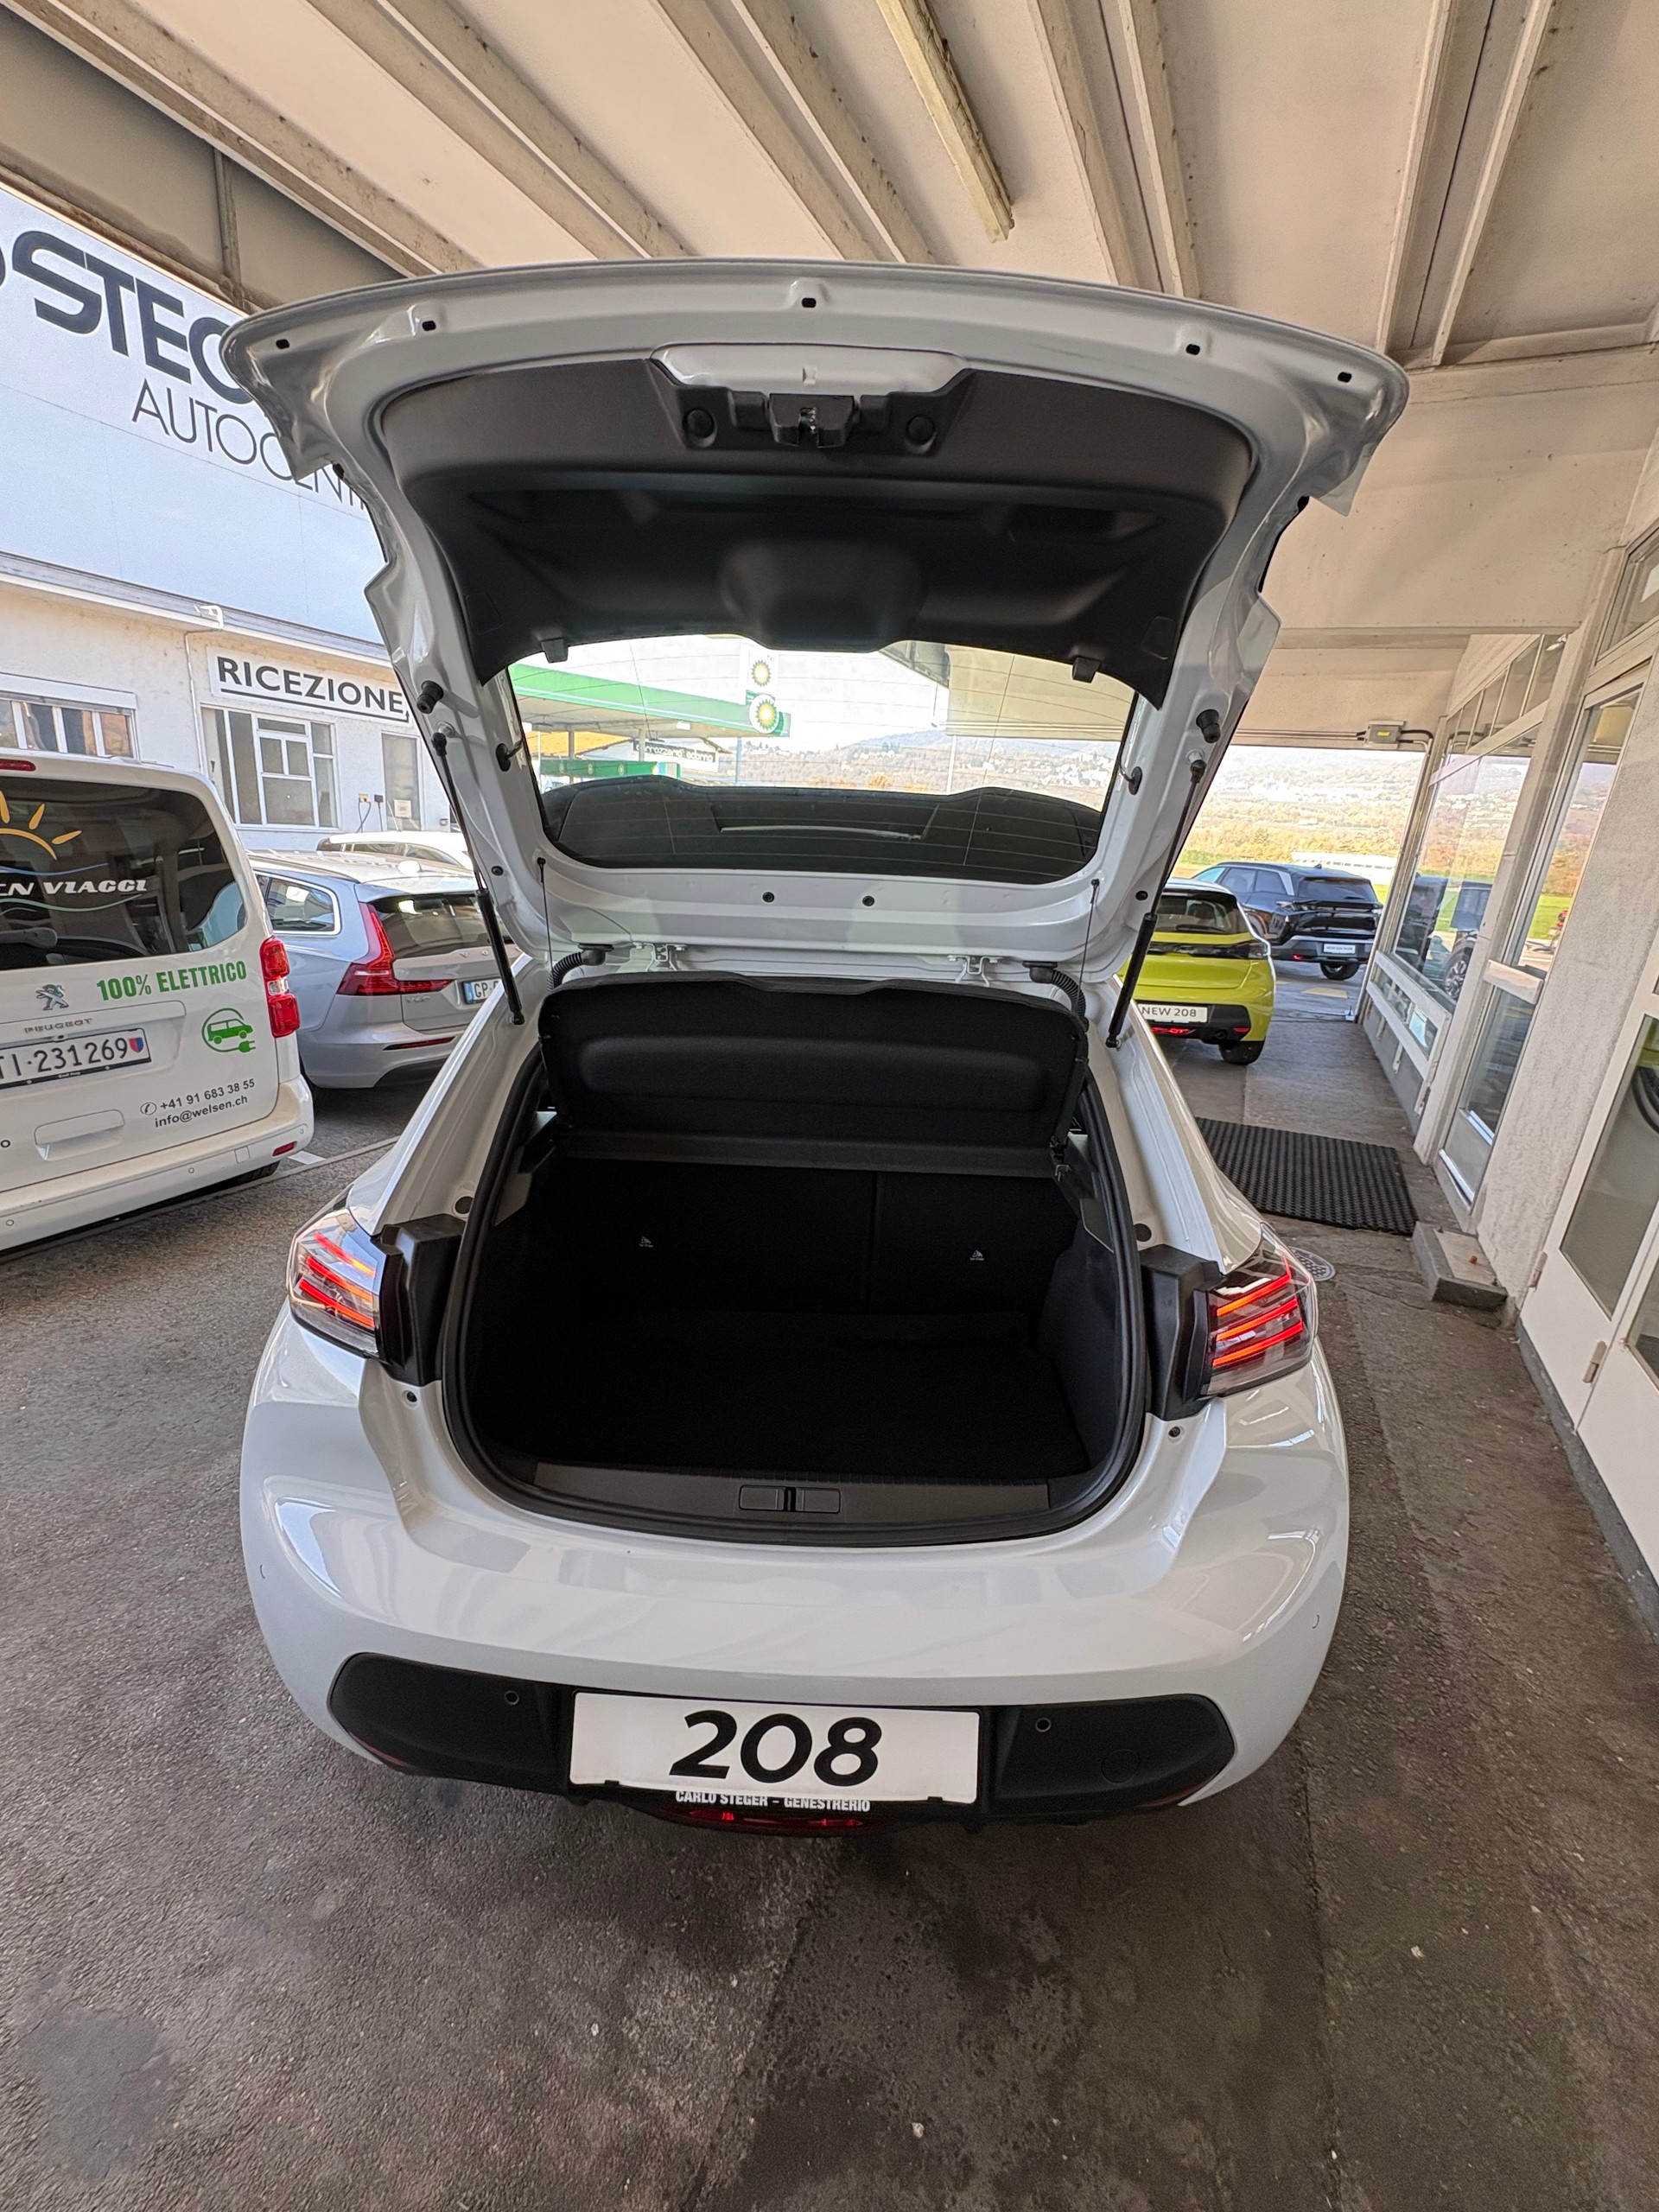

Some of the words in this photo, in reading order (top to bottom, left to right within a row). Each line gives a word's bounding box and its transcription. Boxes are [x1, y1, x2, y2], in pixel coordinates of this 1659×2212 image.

[217, 656, 404, 714] RICEZIONE
[43, 880, 148, 894] VIAGGI
[97, 974, 152, 1001] 100%
[156, 961, 247, 993] ELETTRICO
[24, 1018, 93, 1034] PEUGEOT
[1141, 1007, 1171, 1016] NEW
[1174, 1008, 1197, 1017] 208
[160, 1097, 182, 1110] +41
[186, 1093, 200, 1105] 91
[204, 1087, 225, 1101] 683
[227, 1083, 240, 1095] 38
[243, 1078, 255, 1090] 55
[155, 1095, 248, 1128] info@welsen.ch
[669, 1710, 882, 1787] 208
[676, 1790, 716, 1804] CARLO
[720, 1794, 768, 1807] STEGER
[784, 1796, 870, 1812] GENESTRERIO
